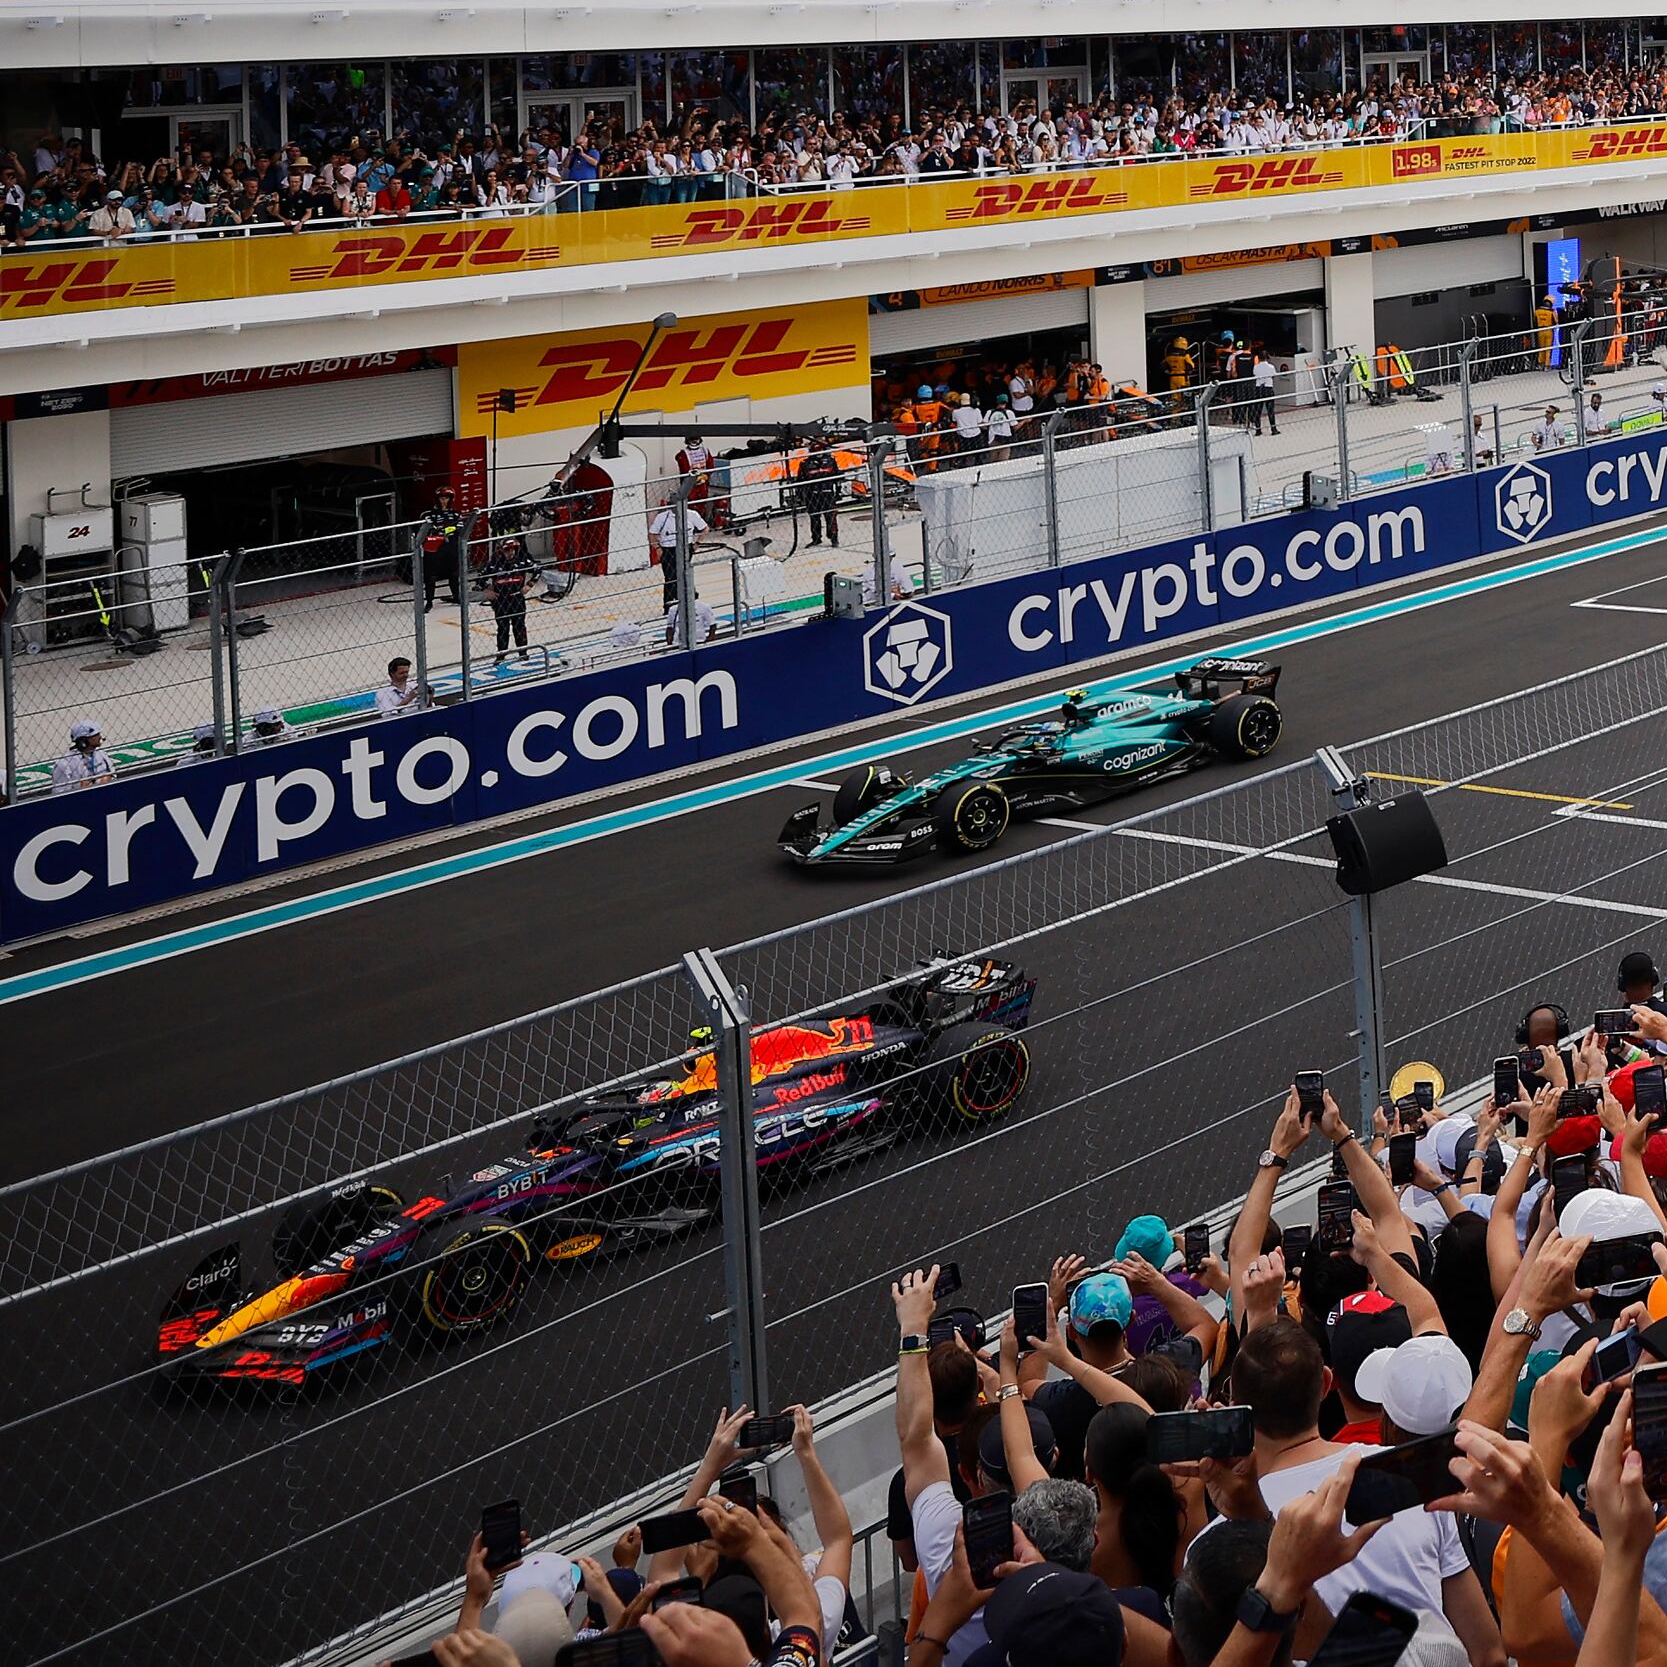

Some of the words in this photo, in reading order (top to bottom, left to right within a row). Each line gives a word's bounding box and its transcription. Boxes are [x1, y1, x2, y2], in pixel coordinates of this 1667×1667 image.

[1445, 161, 1479, 172] FASTEST
[1481, 160, 1496, 169] PIT
[1496, 159, 1516, 167] STOP
[1517, 157, 1537, 166] 2022
[1451, 146, 1486, 159] DHL
[1212, 157, 1323, 194] DHL
[973, 176, 1104, 219] DHL
[1599, 202, 1637, 218] WALK
[1638, 200, 1666, 214] WAY
[683, 201, 847, 245] DHL
[329, 228, 525, 279] DHL
[308, 351, 399, 374] BOTTAS
[535, 319, 811, 405] DHL
[67, 524, 91, 540] 24
[1008, 506, 1424, 652] crypto.com
[1097, 695, 1152, 719] aramco
[1103, 740, 1166, 771] cognizant
[14, 669, 738, 902] crypto.com
[911, 824, 934, 839] BOSS
[861, 1042, 907, 1063] HONDA
[773, 1075, 812, 1105] Red
[811, 1063, 848, 1094] Bull
[653, 1104, 828, 1169] ORCLE
[186, 1264, 231, 1292] Claro
